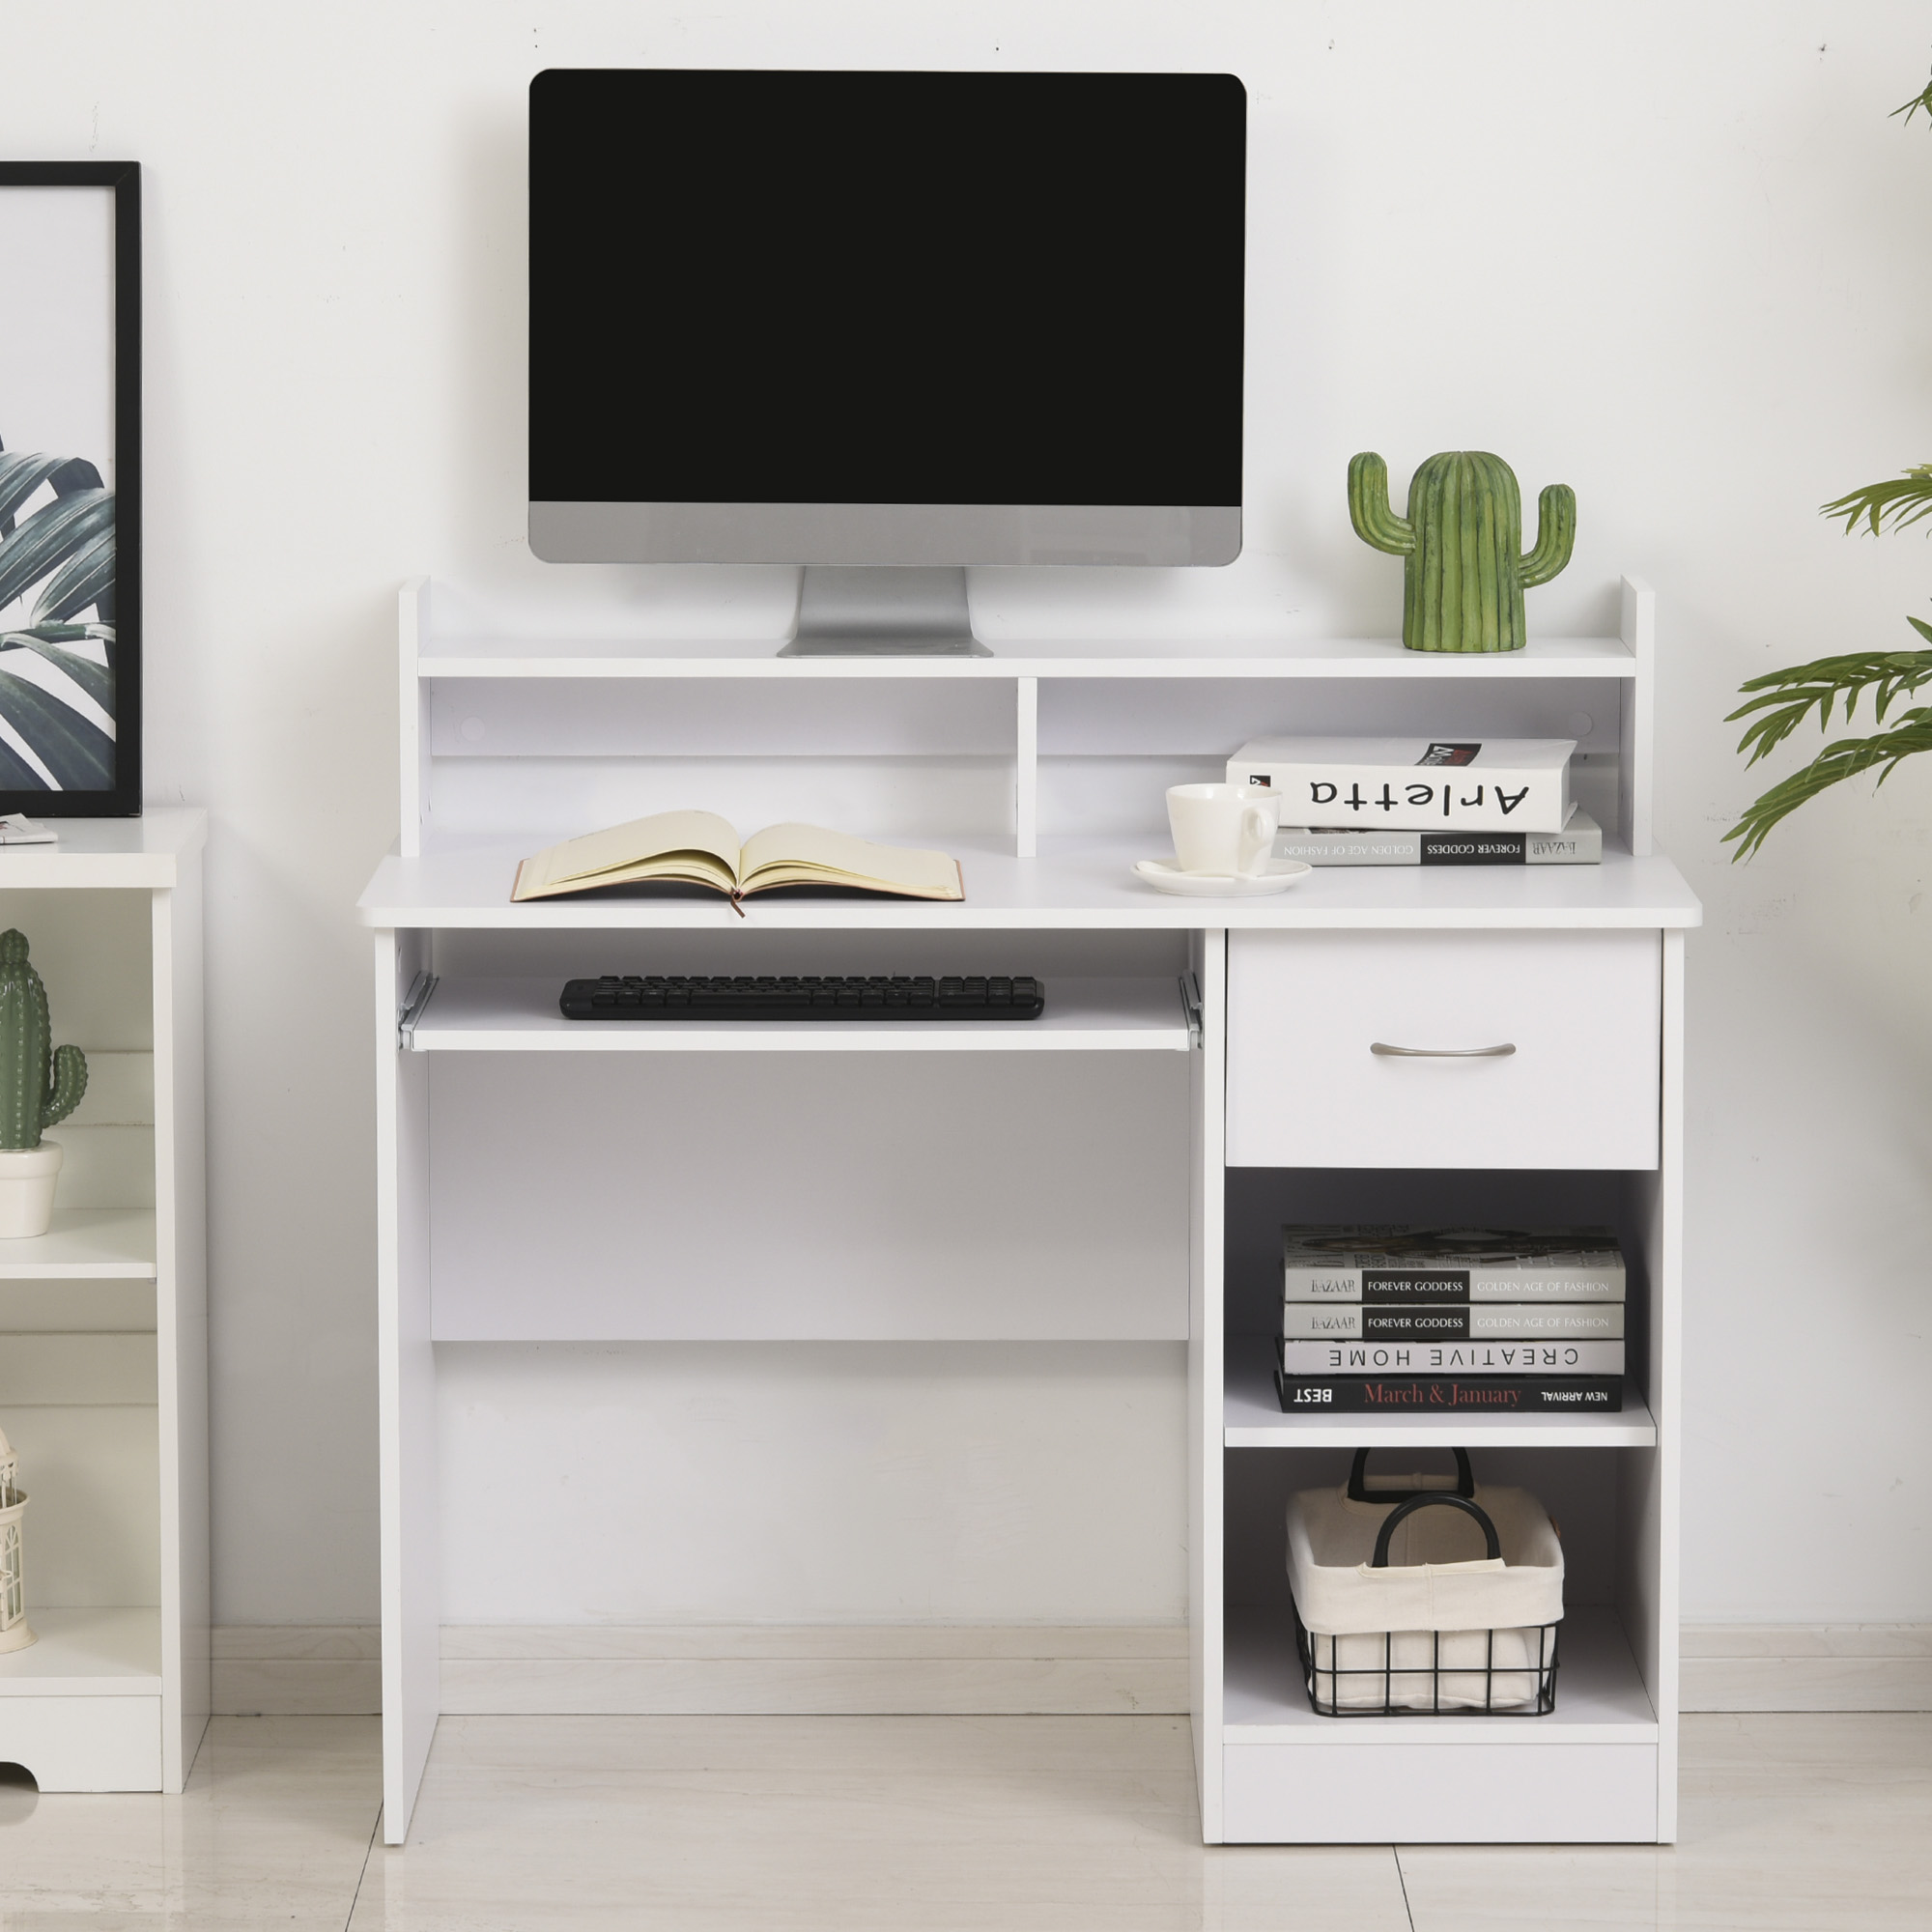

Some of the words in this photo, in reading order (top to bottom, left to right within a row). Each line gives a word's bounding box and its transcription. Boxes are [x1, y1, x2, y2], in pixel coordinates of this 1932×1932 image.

[1309, 781, 1530, 817] Arletta
[1283, 845, 1329, 856] FASHION
[1330, 845, 1346, 856] OF
[1347, 845, 1369, 856] AGE
[1371, 844, 1414, 856] GOLDEN
[1426, 844, 1475, 855] GODDESS
[1477, 844, 1521, 855] FOREVER
[1367, 1281, 1412, 1292] FOREVER
[1414, 1281, 1463, 1292] GODDESS
[1477, 1281, 1520, 1293] GOLDEN
[1522, 1281, 1545, 1293] AGE
[1547, 1281, 1562, 1292] OF
[1564, 1281, 1609, 1293] FASHION
[1367, 1318, 1412, 1328] FOREVER
[1414, 1318, 1463, 1328] GODDESS
[1477, 1318, 1520, 1328] GOLDEN
[1522, 1318, 1545, 1328] AGE
[1547, 1318, 1562, 1328] OF
[1564, 1318, 1609, 1328] FASHION
[1329, 1349, 1410, 1367] HOME
[1431, 1348, 1579, 1366] CREATIVE
[1293, 1388, 1332, 1403] BEST
[1364, 1383, 1424, 1404] March
[1429, 1383, 1445, 1404] &
[1448, 1383, 1521, 1407] January
[1541, 1391, 1583, 1402] ARRIVAL
[1584, 1391, 1608, 1402] NEW
